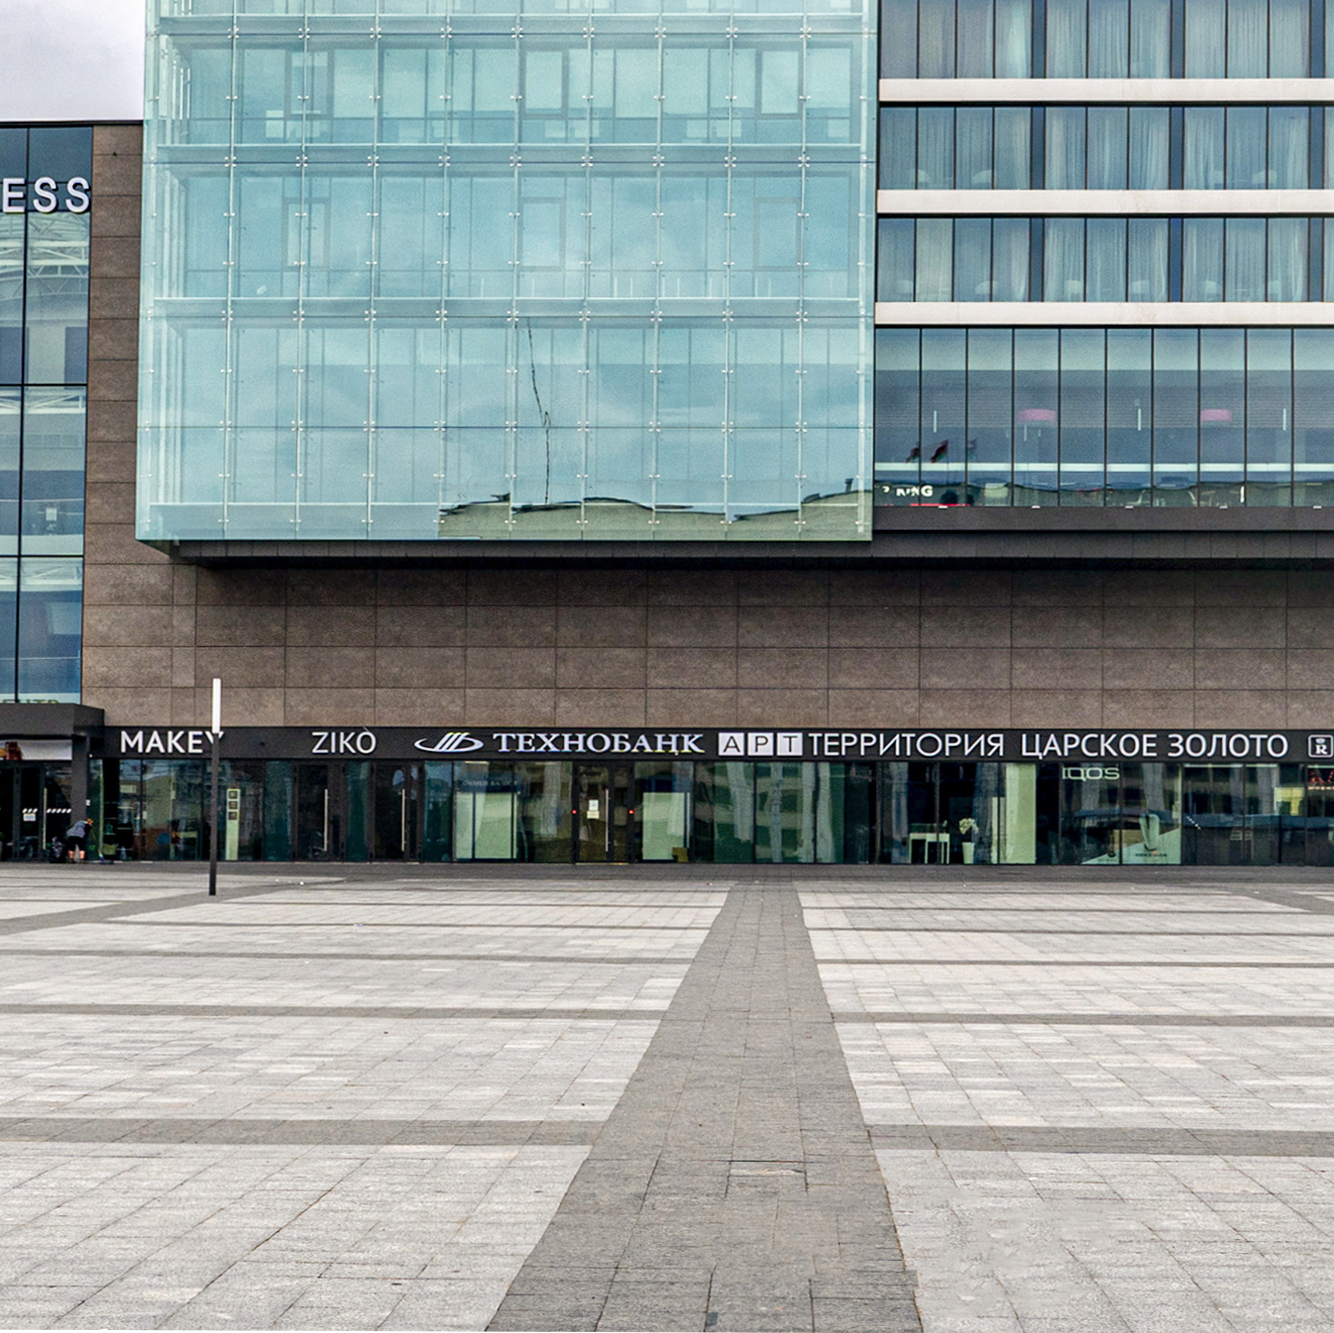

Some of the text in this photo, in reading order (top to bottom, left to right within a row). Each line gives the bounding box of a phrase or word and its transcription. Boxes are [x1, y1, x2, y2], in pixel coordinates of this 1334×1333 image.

[311, 729, 377, 754] ZIKO
[492, 732, 706, 754] ТЕХНОБАНК
[720, 732, 1005, 756] АРТ ТЕРРИТОРИЯ
[1020, 732, 1289, 760] ЦАРСКОЕ ЗОЛОТО
[1061, 766, 1120, 781] IQOS
